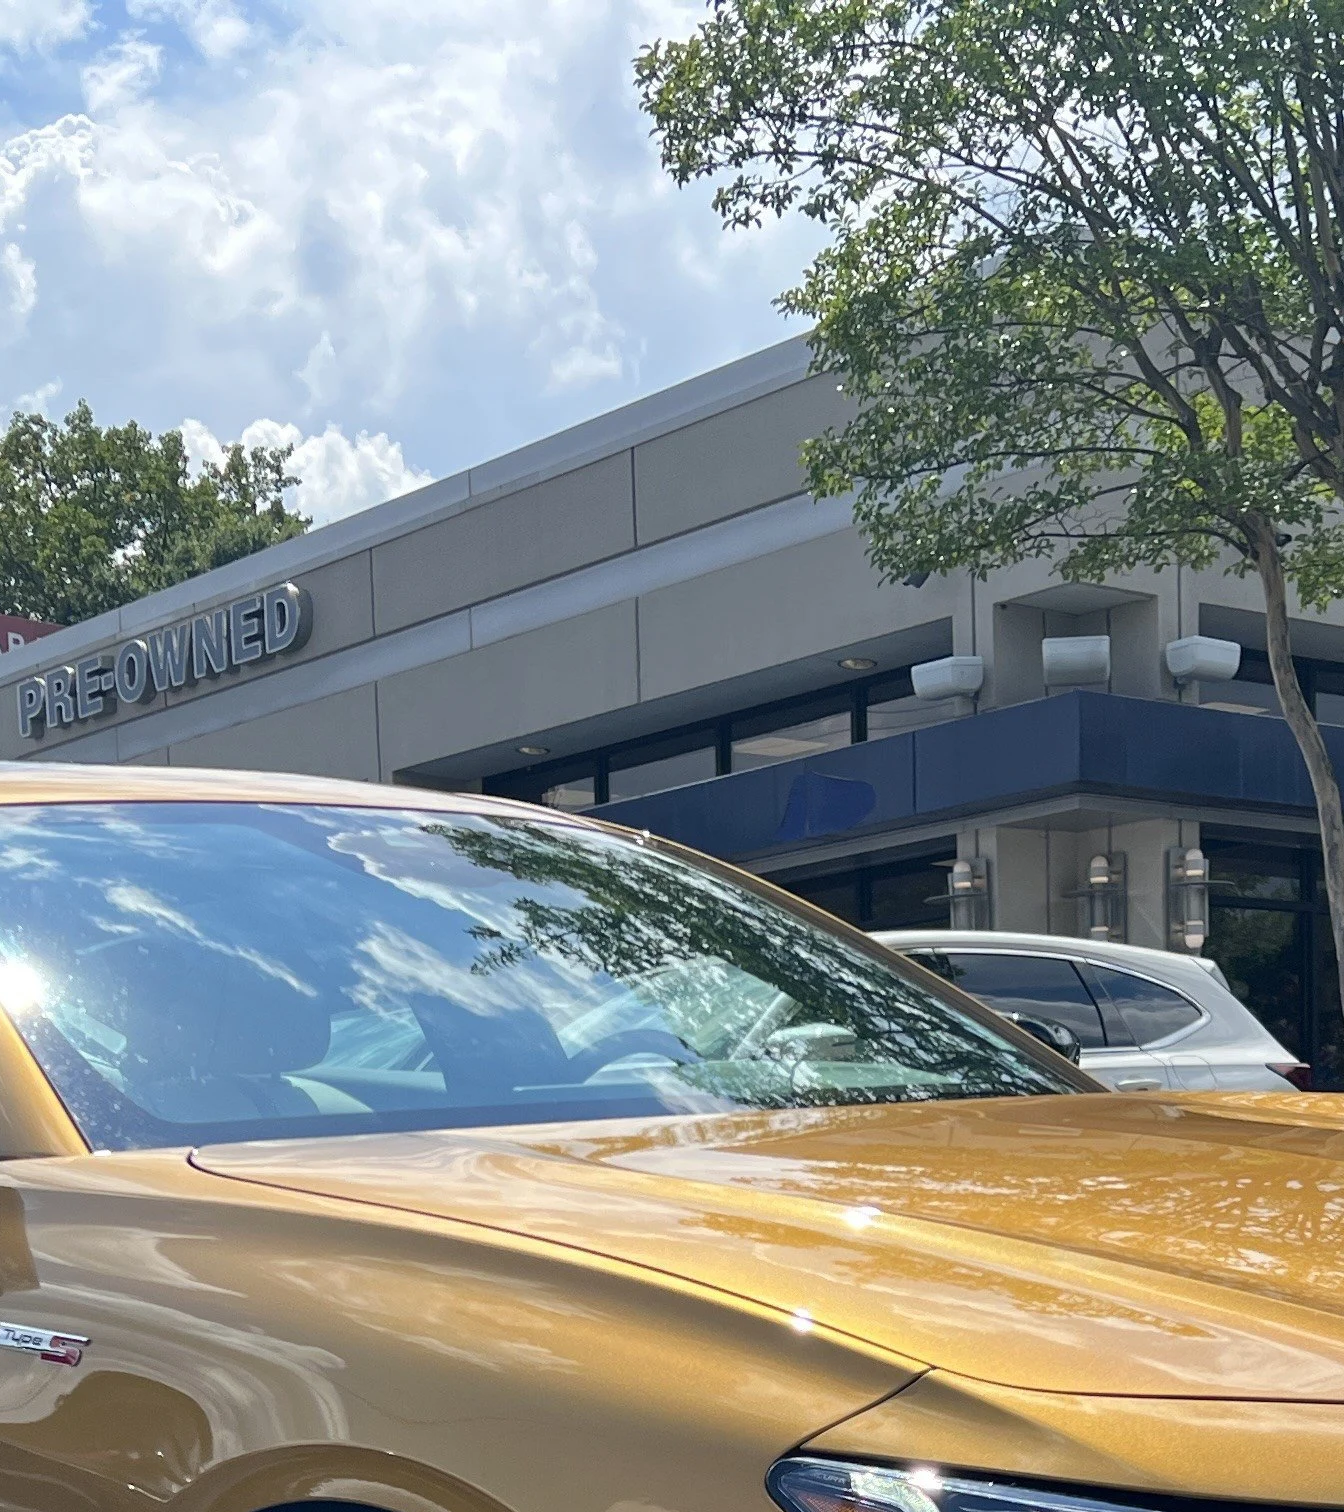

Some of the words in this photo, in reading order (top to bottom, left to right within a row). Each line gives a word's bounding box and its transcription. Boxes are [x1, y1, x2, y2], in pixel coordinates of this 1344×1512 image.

[16, 582, 306, 738] PRE-OWNED
[4, 1328, 43, 1347] Type
[40, 1335, 93, 1368] S
